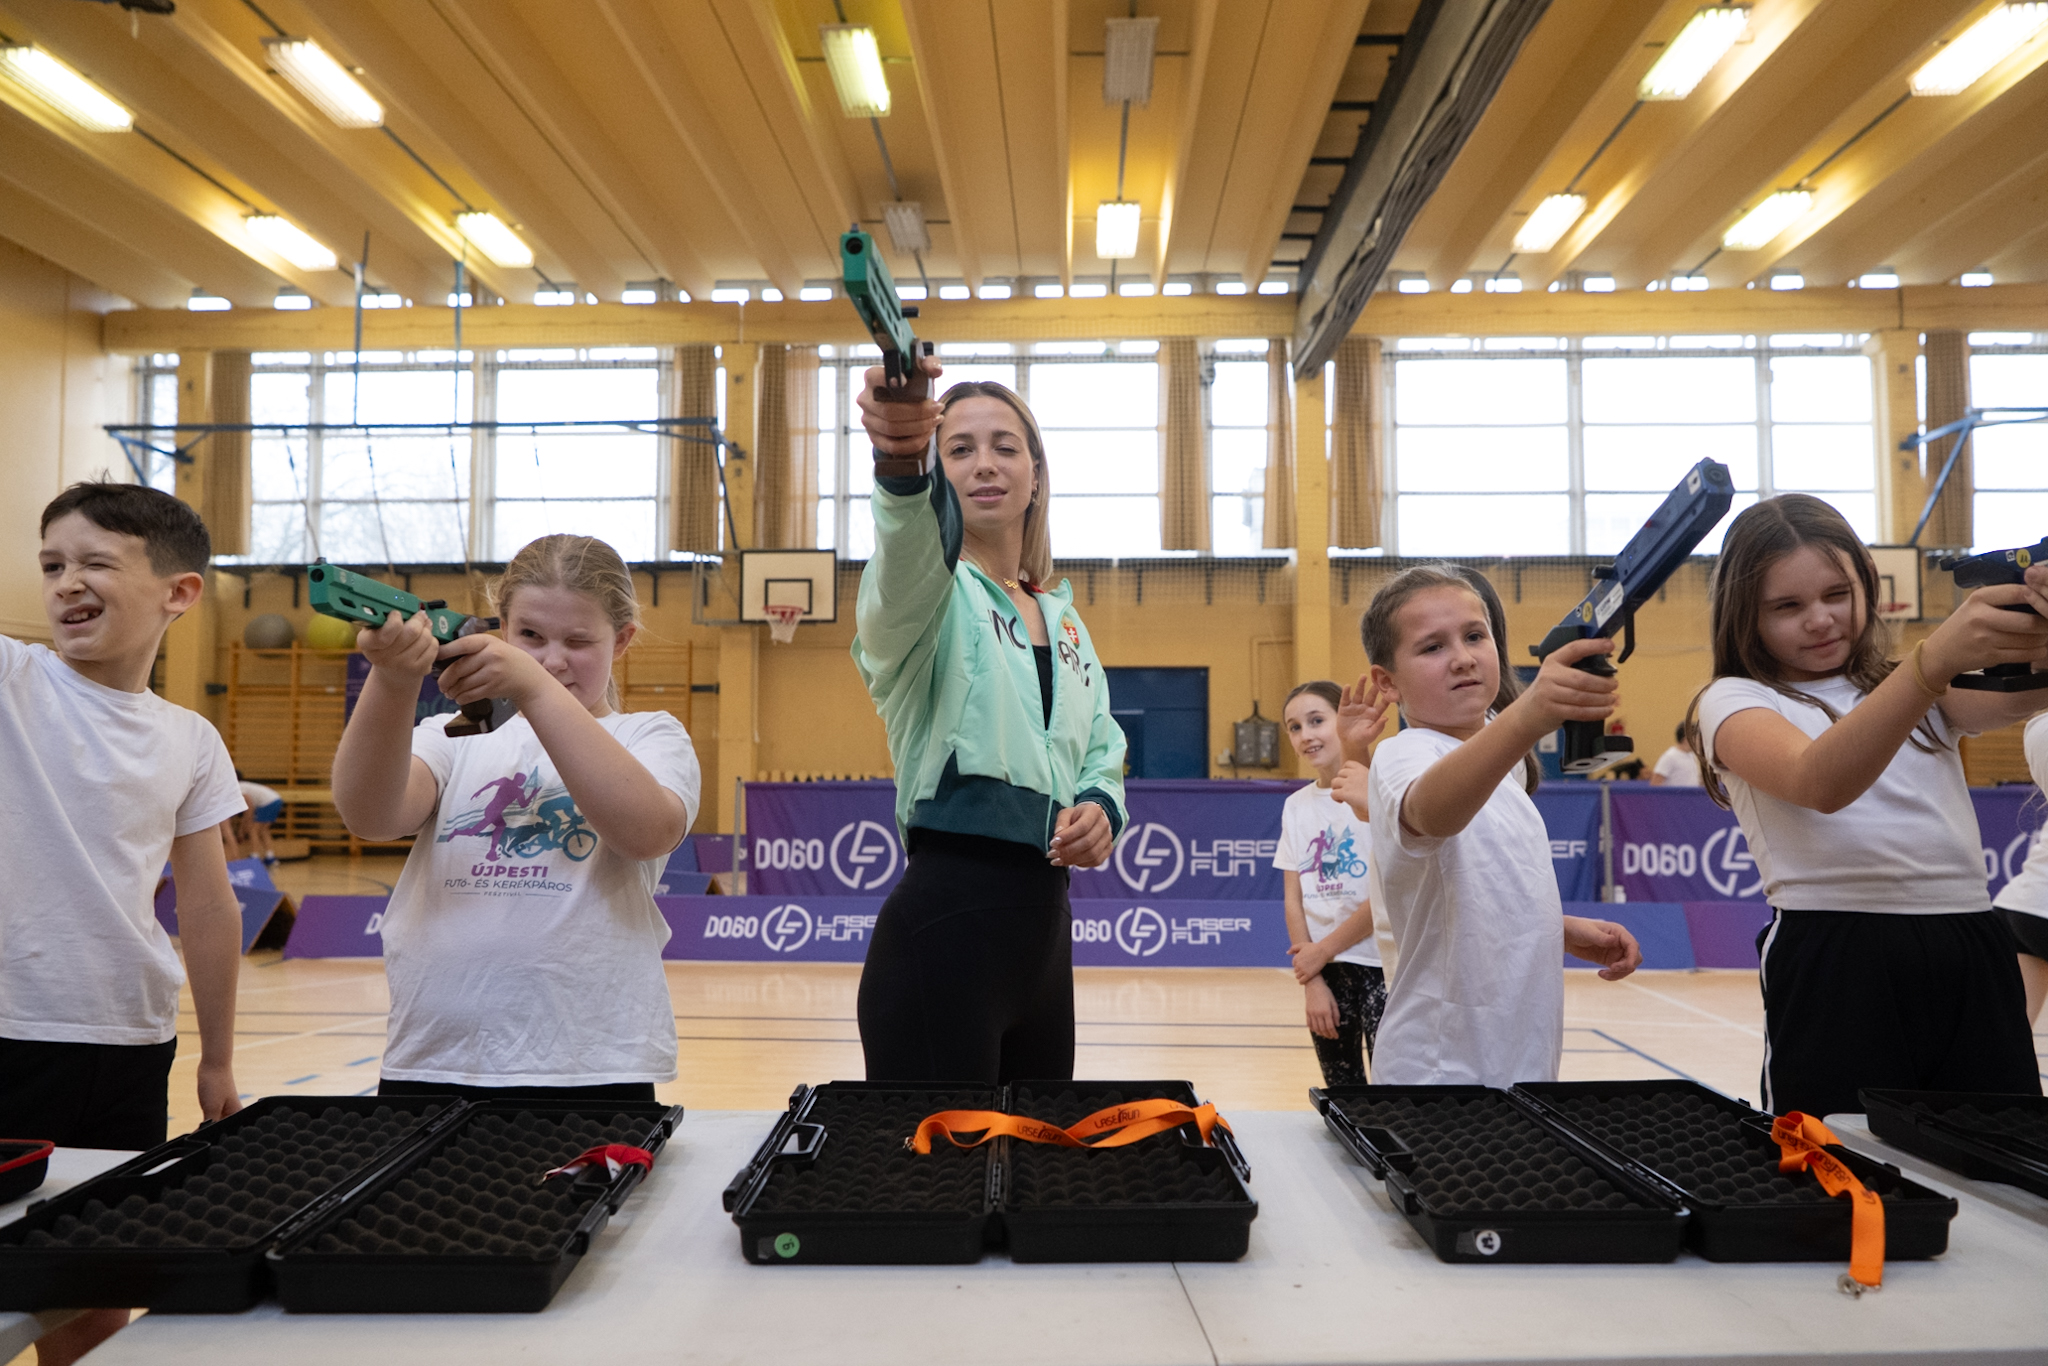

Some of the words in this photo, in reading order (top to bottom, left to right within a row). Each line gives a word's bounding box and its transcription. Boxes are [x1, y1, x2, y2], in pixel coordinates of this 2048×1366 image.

[1190, 839, 1278, 857] LASE
[471, 863, 549, 878] ÚJPESTI
[1190, 858, 1256, 876] FUN
[474, 877, 489, 888] ÉS
[493, 879, 573, 893] KERÉKPÁROS
[816, 915, 879, 929] LASE
[1171, 918, 1251, 931] LASER
[815, 928, 864, 941] FUN
[1171, 931, 1221, 944] FUN
